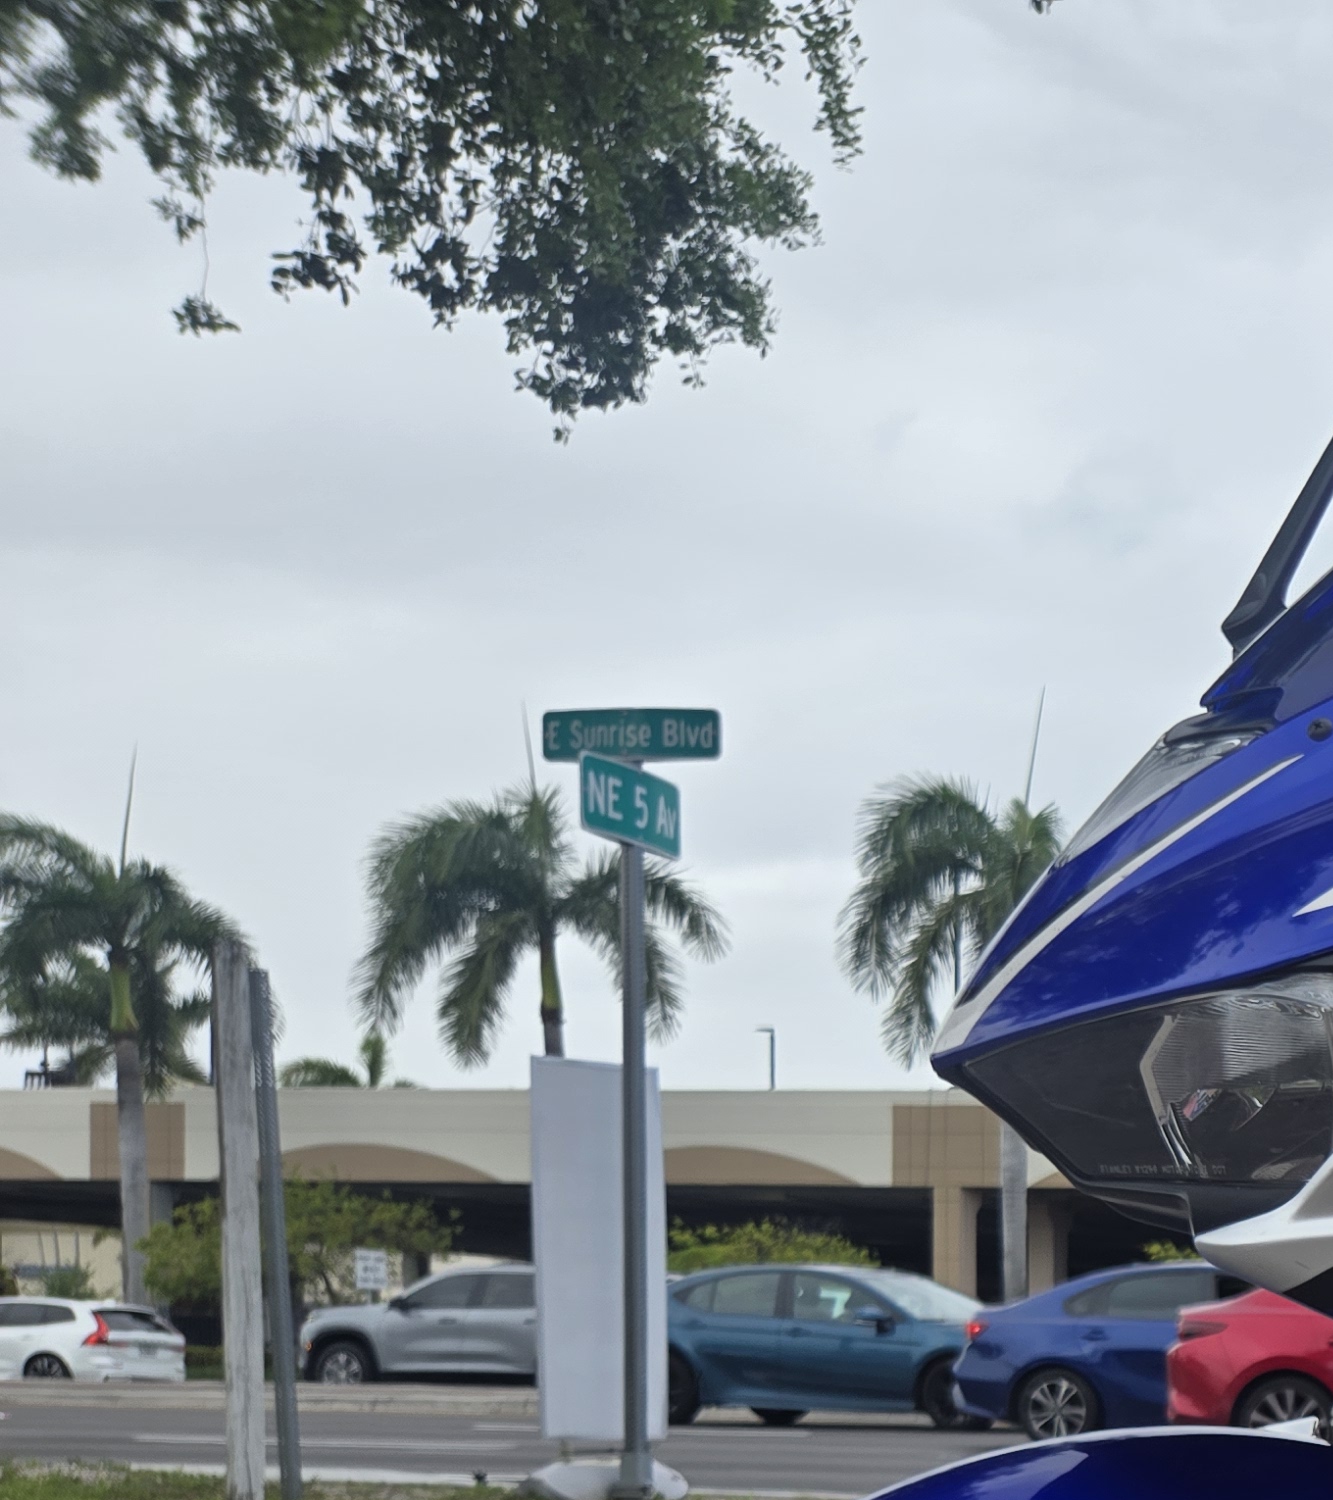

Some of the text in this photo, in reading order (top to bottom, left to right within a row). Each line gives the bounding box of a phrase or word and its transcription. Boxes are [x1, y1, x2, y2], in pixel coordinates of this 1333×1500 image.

[548, 719, 713, 749] E Sunrise Blvd
[588, 770, 623, 821] NE
[635, 786, 649, 829] 5
